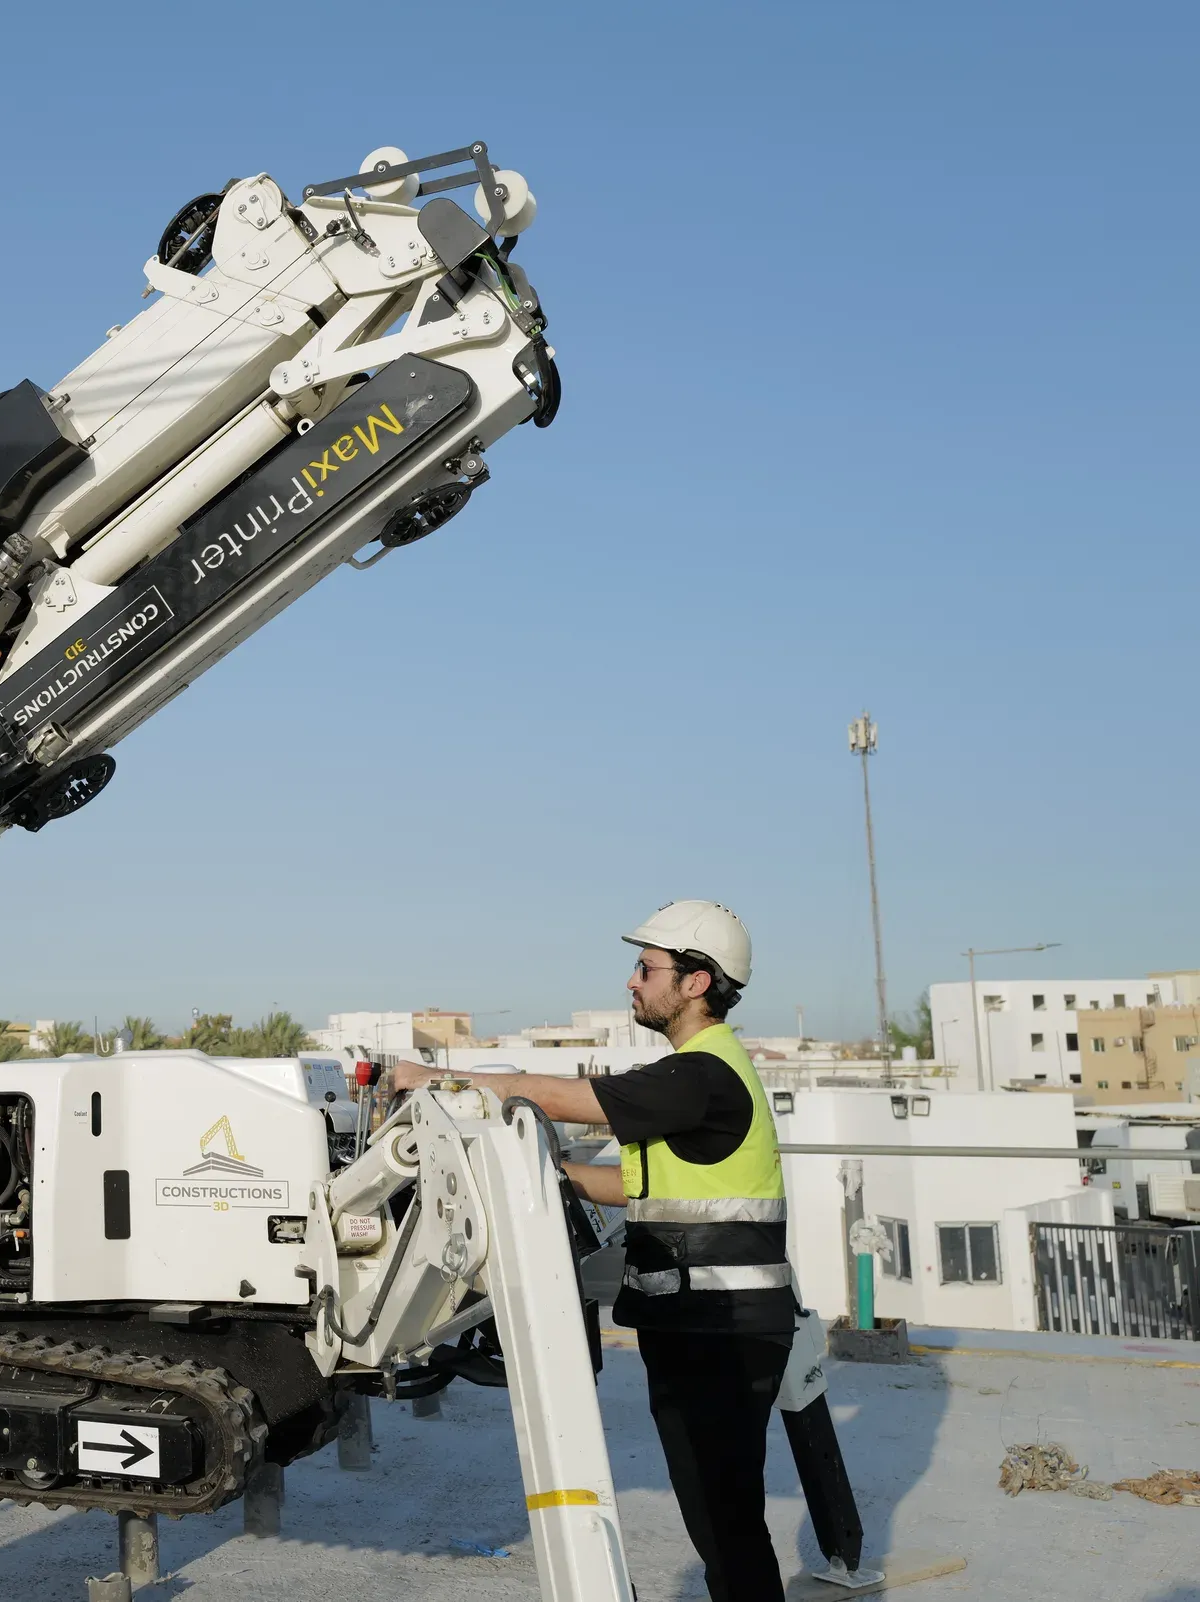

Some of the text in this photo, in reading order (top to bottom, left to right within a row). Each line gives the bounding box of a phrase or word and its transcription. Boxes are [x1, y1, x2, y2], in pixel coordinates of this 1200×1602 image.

[189, 403, 406, 585] MaxiPrinter
[64, 637, 88, 661] 3D
[12, 603, 159, 727] CONSTRUCTIONS
[622, 1168, 637, 1177] EEN
[162, 1186, 282, 1200] CONSTRUCTIONS
[213, 1202, 229, 1211] 3D
